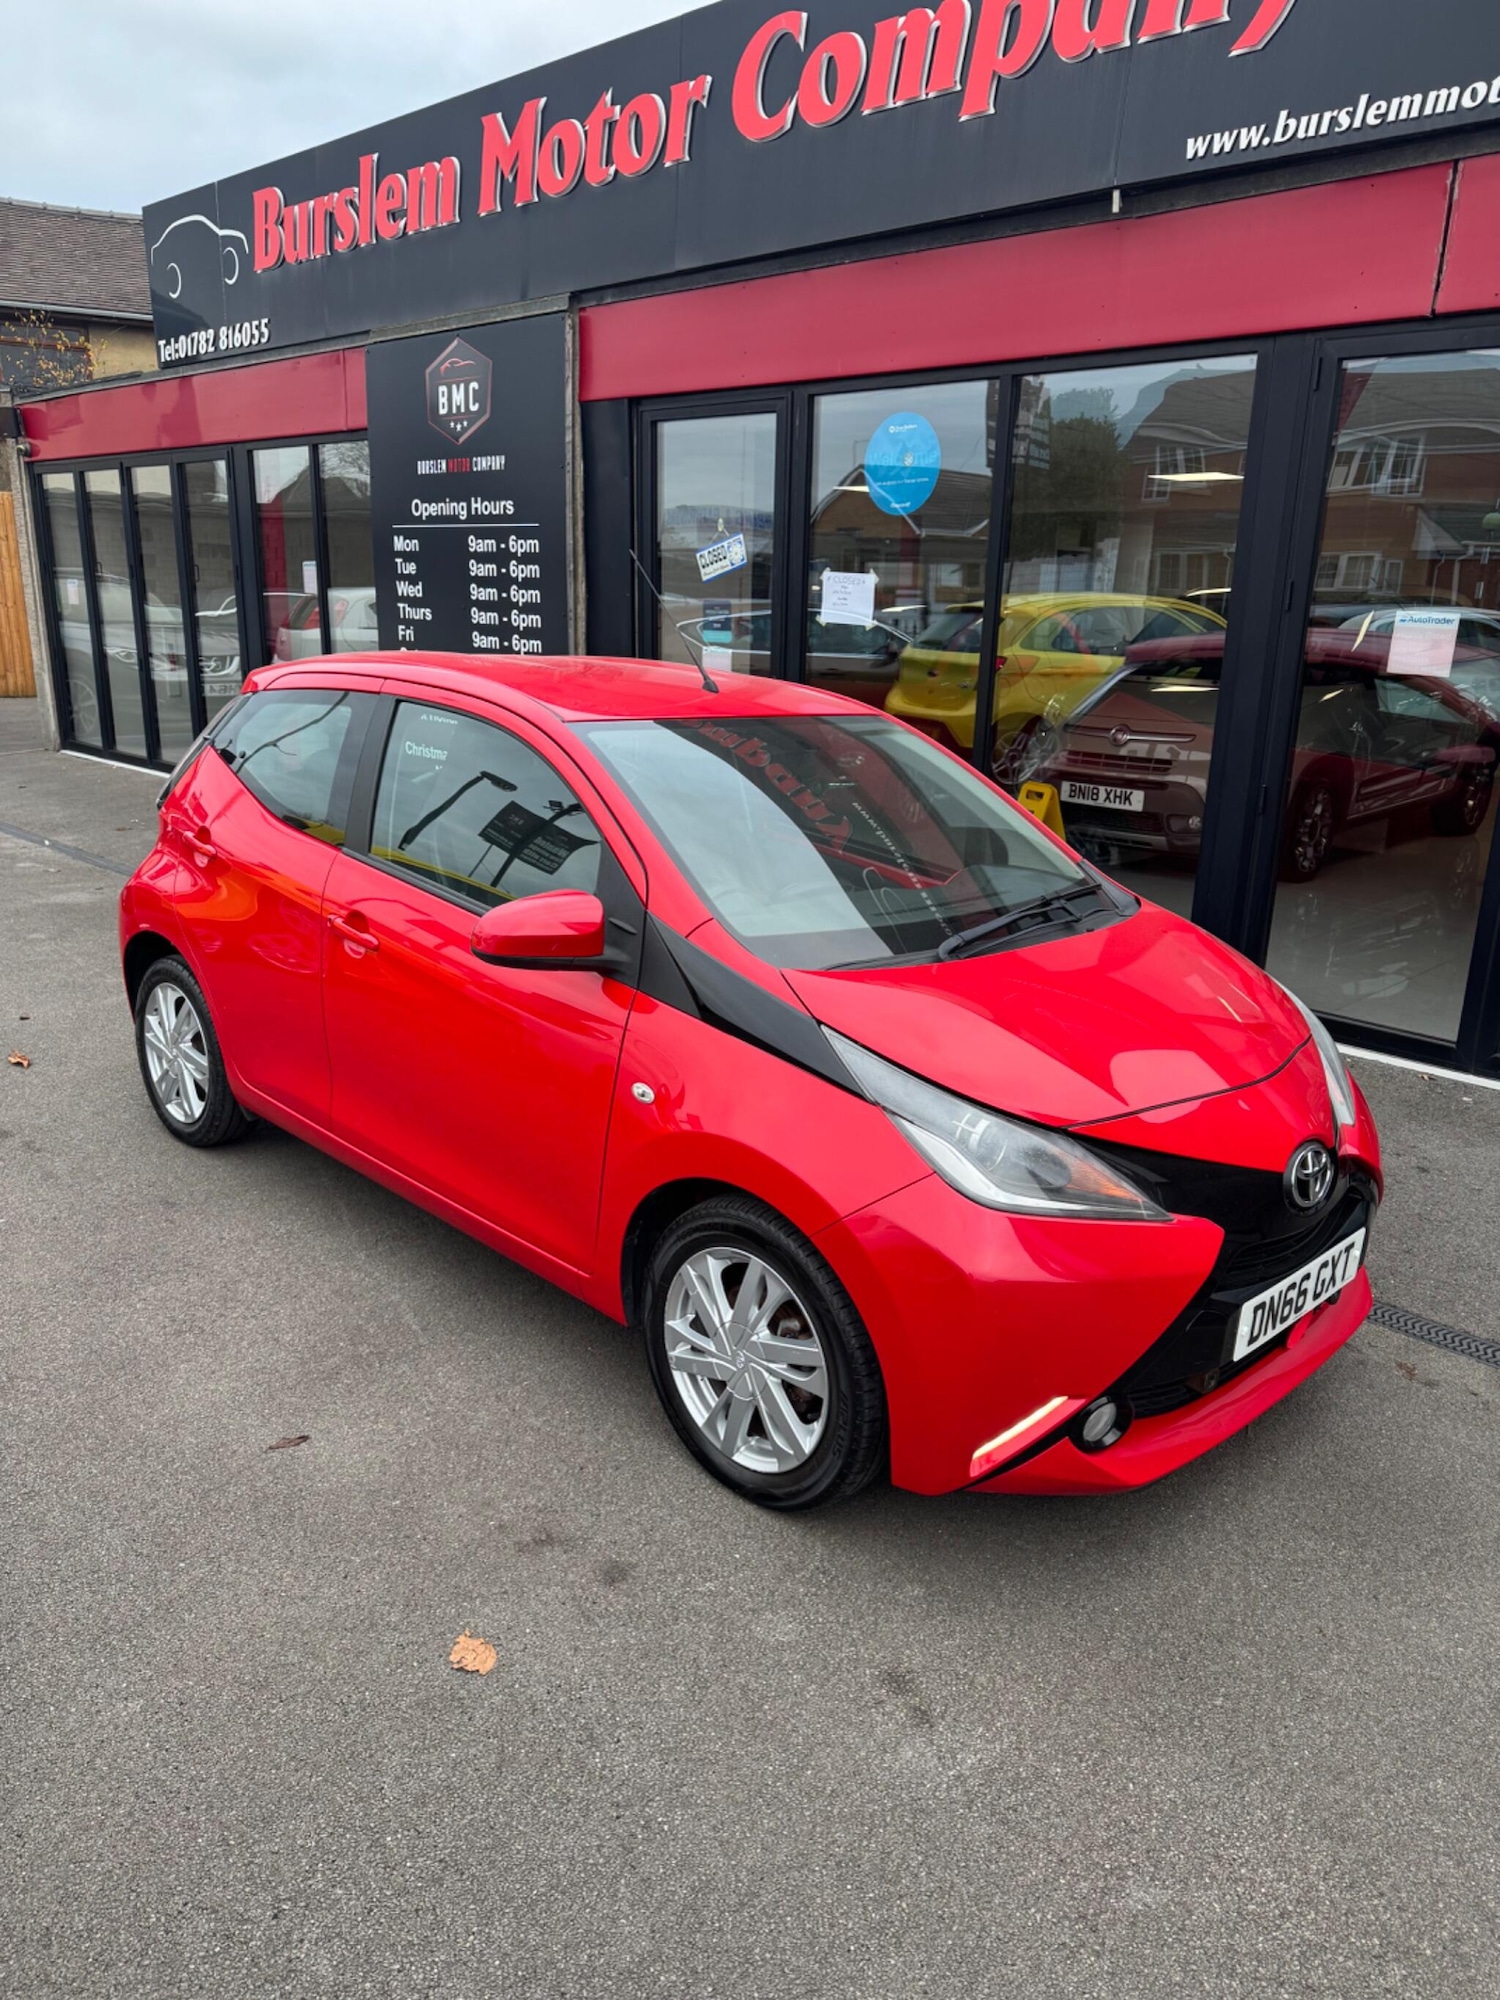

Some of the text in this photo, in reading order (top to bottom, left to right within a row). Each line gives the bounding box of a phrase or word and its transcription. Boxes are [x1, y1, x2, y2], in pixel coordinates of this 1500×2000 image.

[253, 0, 1294, 274] Burslem Motor Compa
[158, 318, 270, 362] Tel:01782 816055
[438, 381, 480, 415] BMC
[472, 455, 505, 472] COMPANY
[411, 497, 514, 520] Opening Hours
[393, 535, 419, 551] Mon
[468, 535, 496, 552] 9am
[508, 535, 539, 557] 6pm
[395, 558, 417, 574] Tue
[469, 559, 497, 577] 9am
[509, 560, 540, 582] 6pm
[396, 581, 423, 597] Wed
[470, 583, 498, 601] 9am
[510, 585, 541, 607] 6pm
[397, 603, 432, 621] Thurs
[471, 607, 499, 625] 9am
[511, 609, 542, 631] 6pm
[1407, 615, 1456, 625] AutoTrader
[398, 625, 415, 642] Fri
[472, 631, 500, 649] 9am
[511, 634, 542, 655] 6pm
[1068, 783, 1133, 806] BN18 XHK
[1247, 1241, 1355, 1347] DN66 GXT
